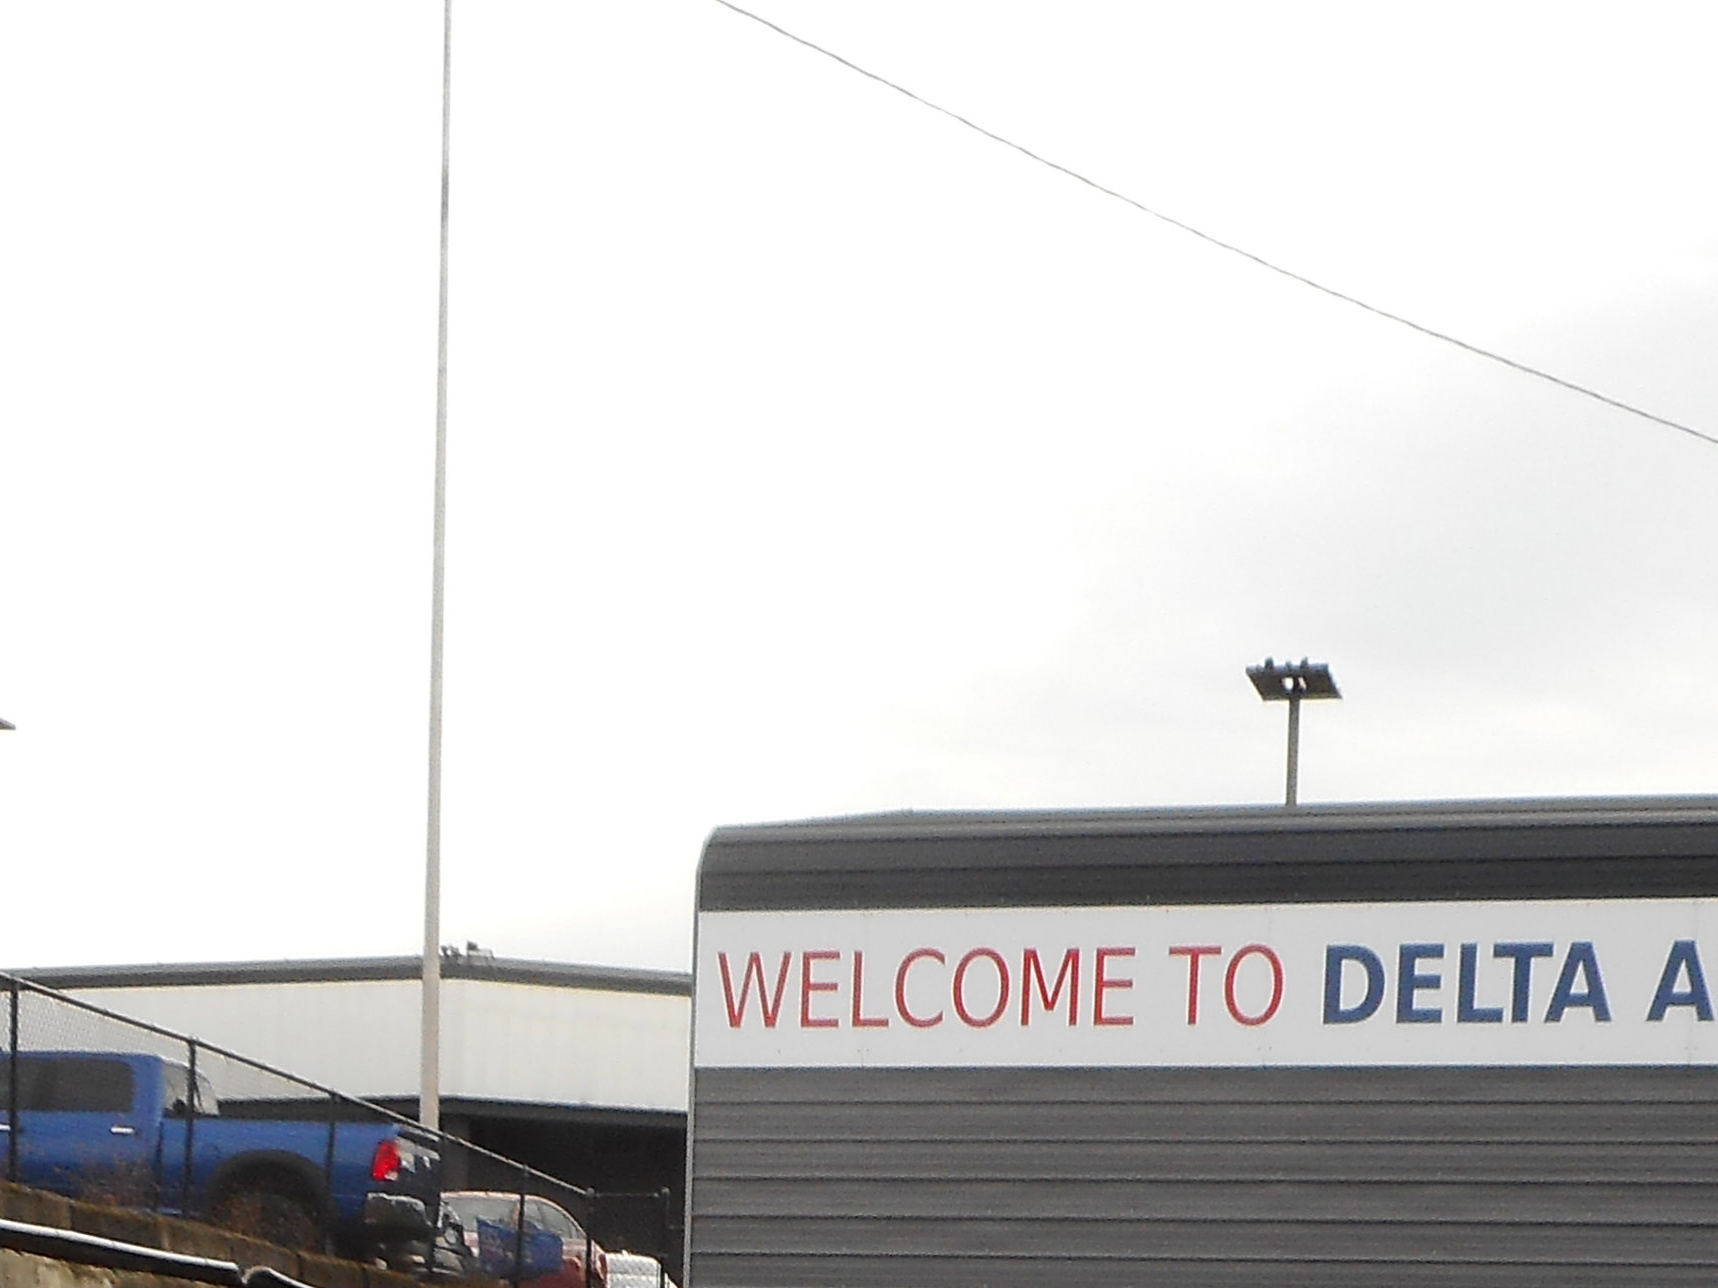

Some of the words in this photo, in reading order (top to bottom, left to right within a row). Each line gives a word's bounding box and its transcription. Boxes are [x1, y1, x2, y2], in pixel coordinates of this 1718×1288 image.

[717, 946, 1136, 1029] WELCOME
[1168, 944, 1285, 1028] TO
[1322, 940, 1612, 1026] DELTA
